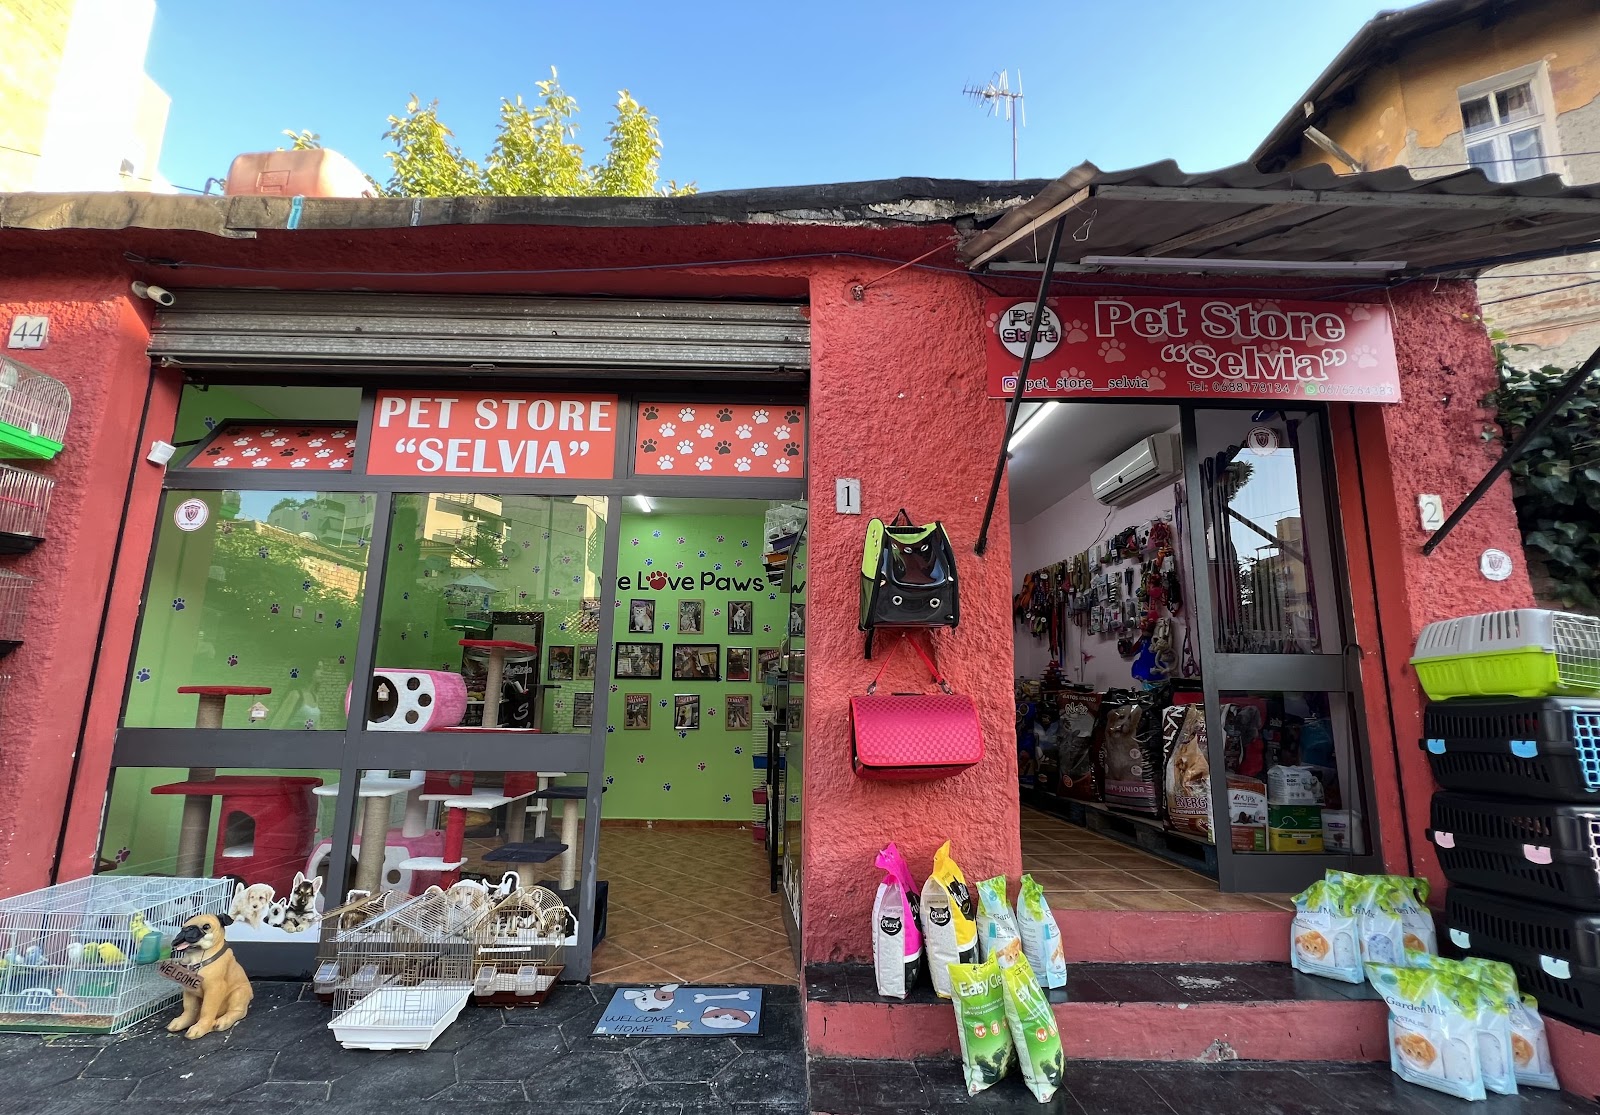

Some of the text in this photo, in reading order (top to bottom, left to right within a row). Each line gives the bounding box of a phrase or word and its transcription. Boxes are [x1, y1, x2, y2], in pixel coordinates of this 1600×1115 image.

[1094, 299, 1346, 342] Pet Store
[13, 321, 43, 342] 44
[1187, 381, 1208, 392] Tel:
[378, 397, 612, 432] PET STORE
[844, 485, 851, 507] 1
[1425, 501, 1440, 523] 2
[700, 571, 765, 592] Paws
[1174, 794, 1208, 809] ENERG
[159, 961, 201, 989] WELCOME
[1386, 995, 1447, 1018] Garden Mix
[605, 1015, 673, 1023] WELCOME
[614, 1024, 654, 1033] HOME
